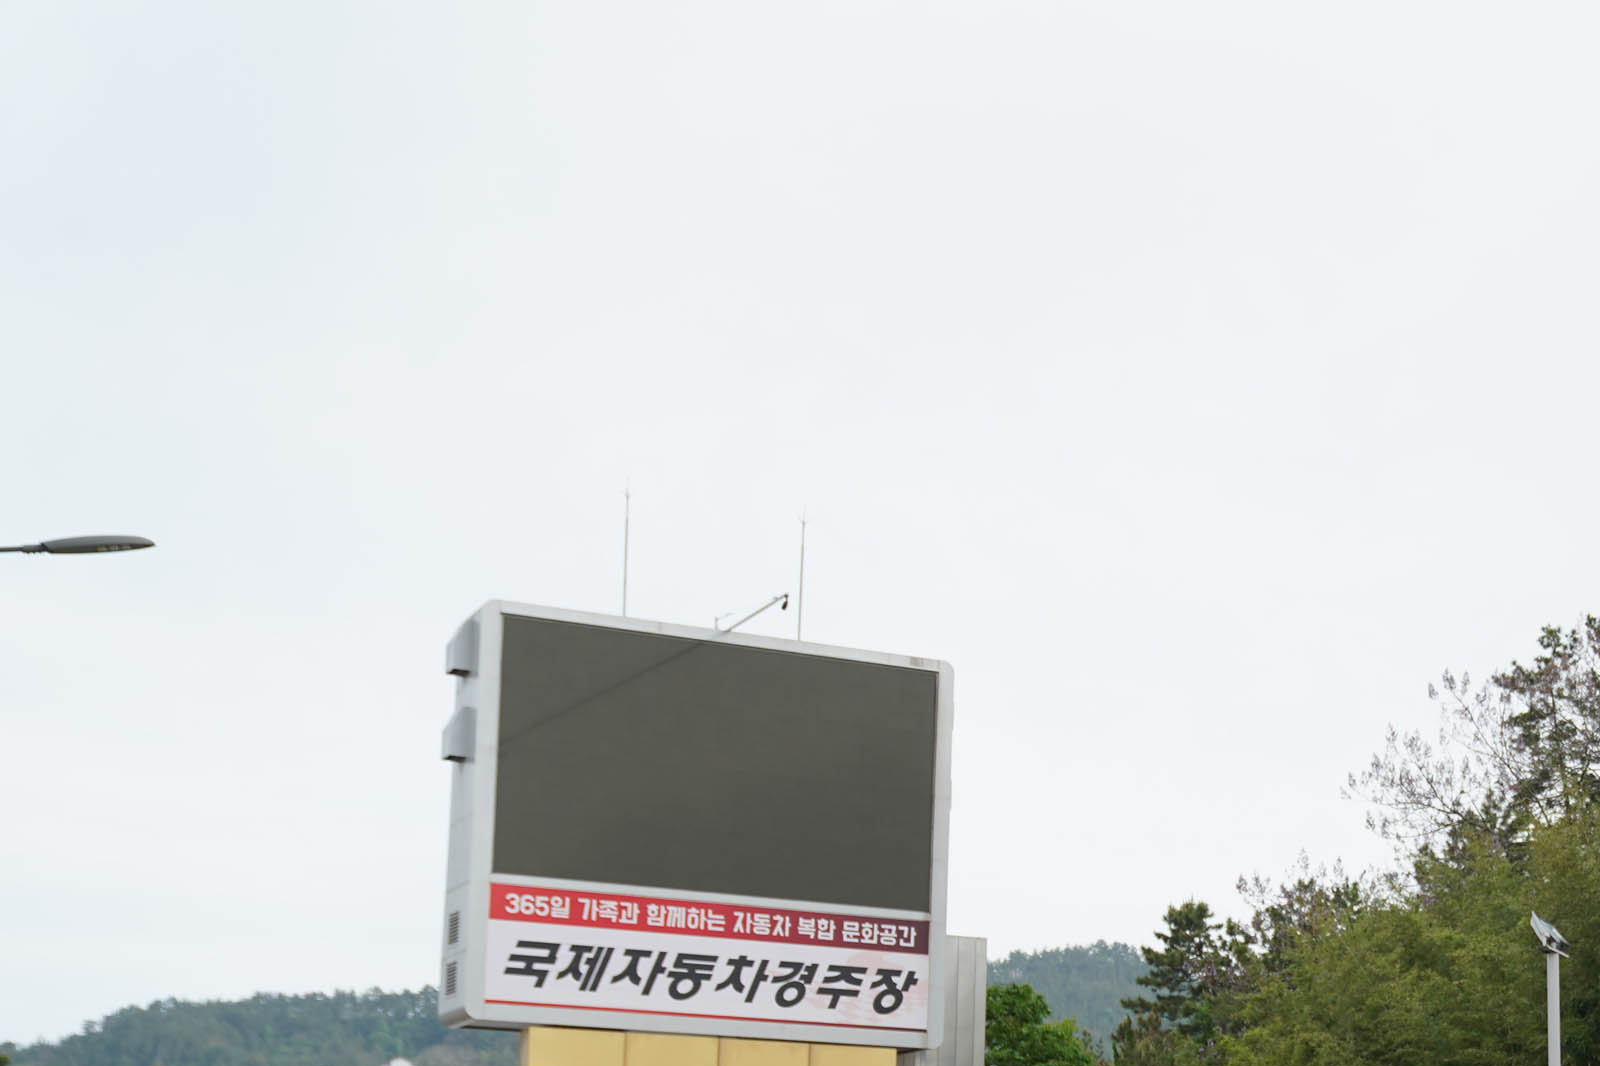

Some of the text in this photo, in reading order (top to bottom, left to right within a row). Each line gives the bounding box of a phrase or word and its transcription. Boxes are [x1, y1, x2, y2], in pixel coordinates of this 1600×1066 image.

[504, 893, 918, 948] 365일 가족과 함께하는 자동차 복합 문화공간
[504, 940, 918, 1015] 국제자동차경주장
